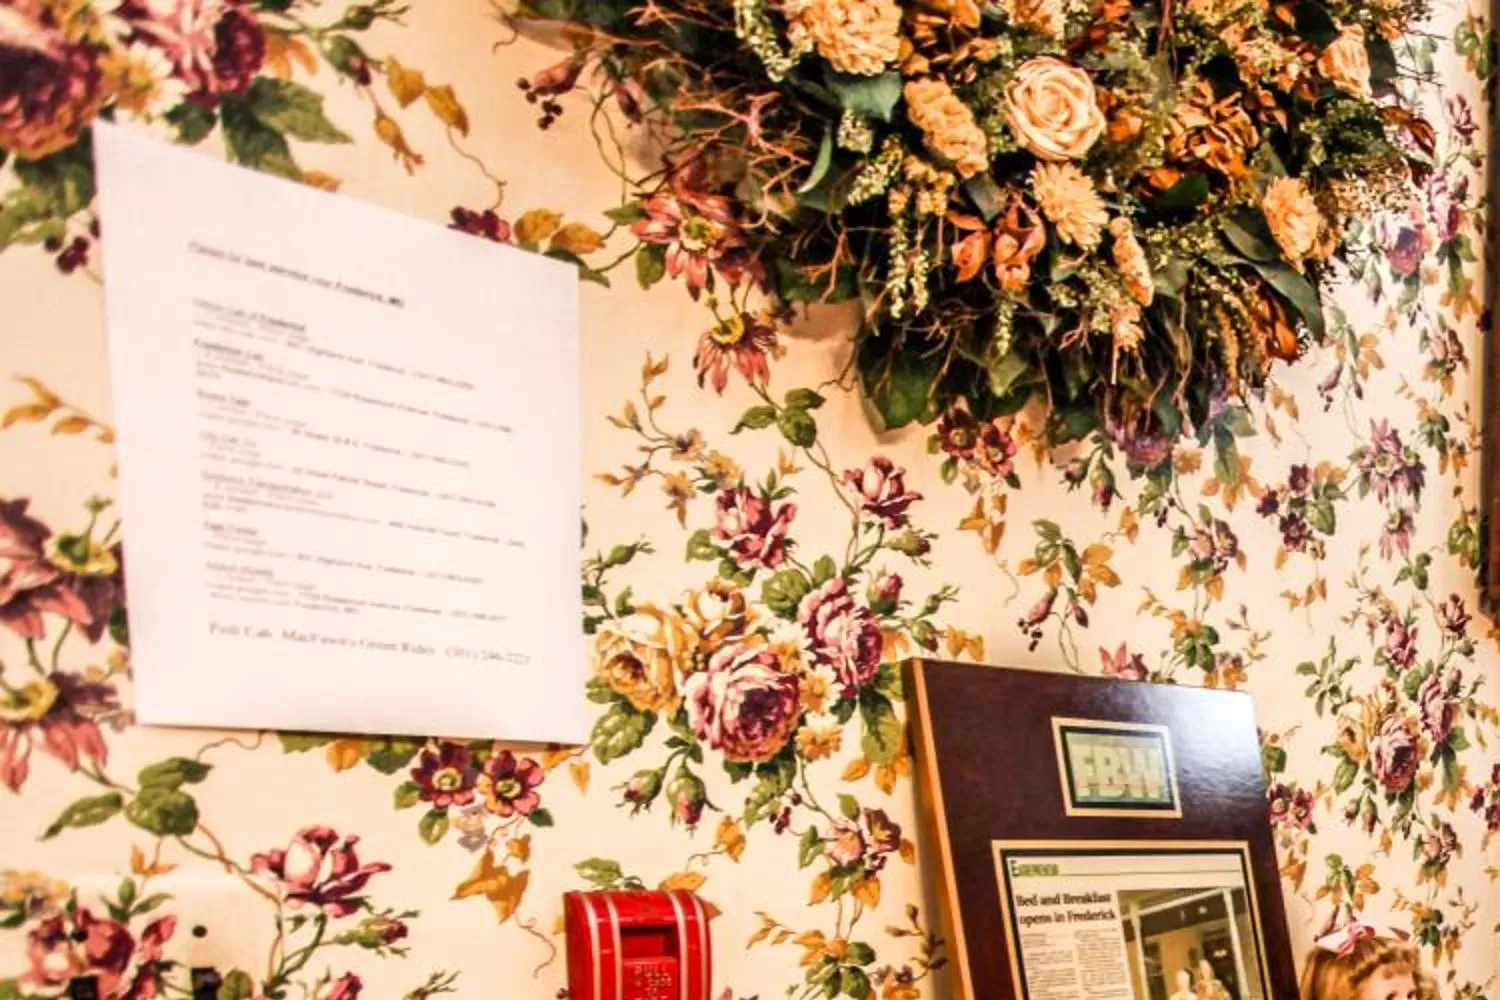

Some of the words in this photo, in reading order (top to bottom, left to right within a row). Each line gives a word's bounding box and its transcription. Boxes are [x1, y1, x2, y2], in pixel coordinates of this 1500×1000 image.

[1016, 893, 1038, 906] Bed
[1040, 893, 1060, 905] and
[1063, 891, 1112, 905] Breakfast
[1020, 914, 1053, 928] opens
[1054, 911, 1065, 922] in
[1067, 908, 1115, 922] Frederick
